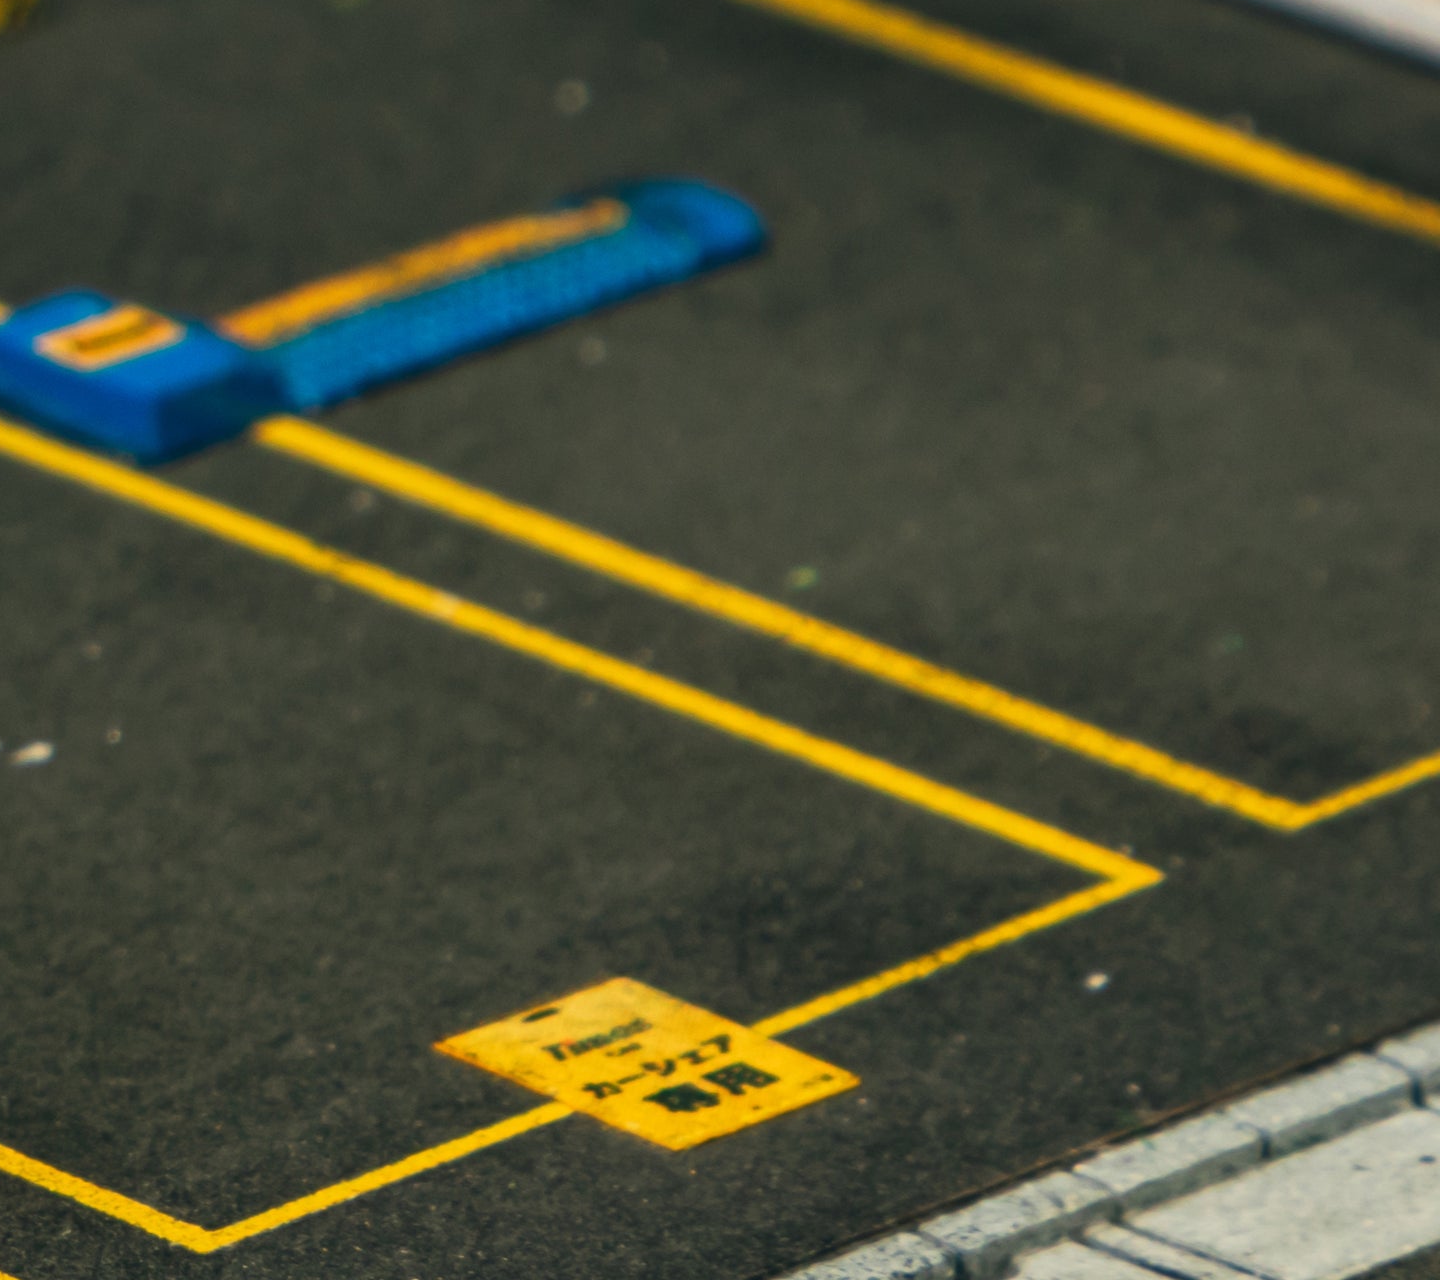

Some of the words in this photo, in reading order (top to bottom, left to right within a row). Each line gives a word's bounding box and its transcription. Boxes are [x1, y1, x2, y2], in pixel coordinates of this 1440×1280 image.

[582, 1033, 732, 1100] カーシェア
